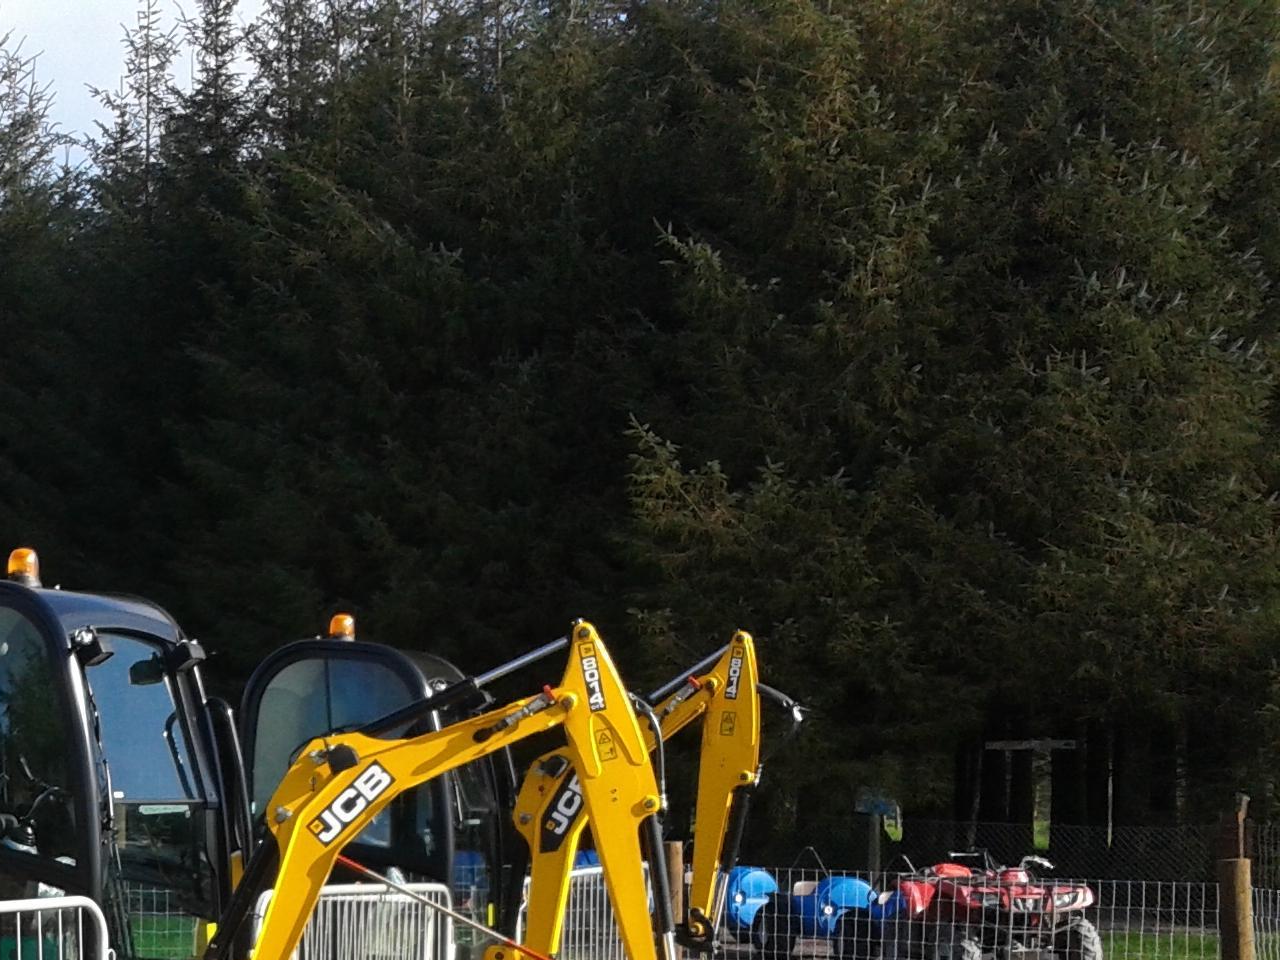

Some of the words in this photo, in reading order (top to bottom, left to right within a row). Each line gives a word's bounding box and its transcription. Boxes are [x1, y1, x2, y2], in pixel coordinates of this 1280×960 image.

[582, 656, 604, 705] 8014
[725, 658, 741, 697] 8014
[318, 764, 392, 843] JCB
